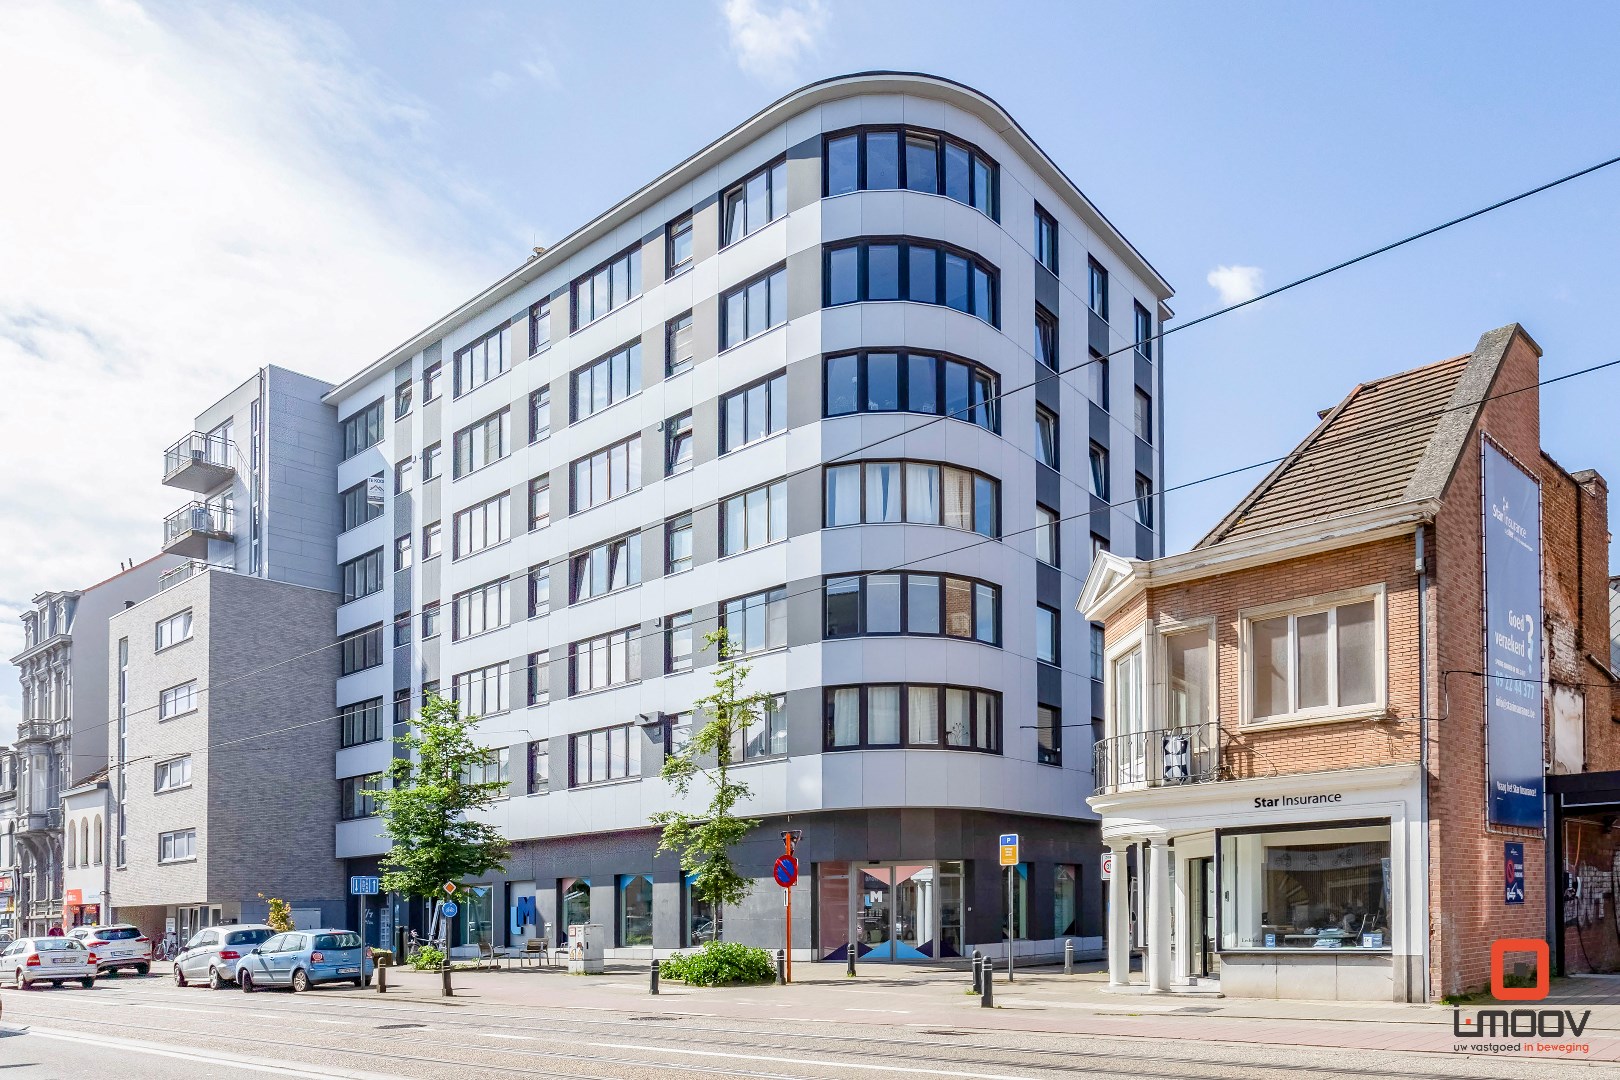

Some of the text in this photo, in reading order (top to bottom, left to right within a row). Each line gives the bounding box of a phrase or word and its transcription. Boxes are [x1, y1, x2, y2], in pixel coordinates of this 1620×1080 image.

[1508, 610, 1525, 632] Goed
[1494, 631, 1525, 658] verzekerd
[1254, 793, 1342, 808] Star Insurance
